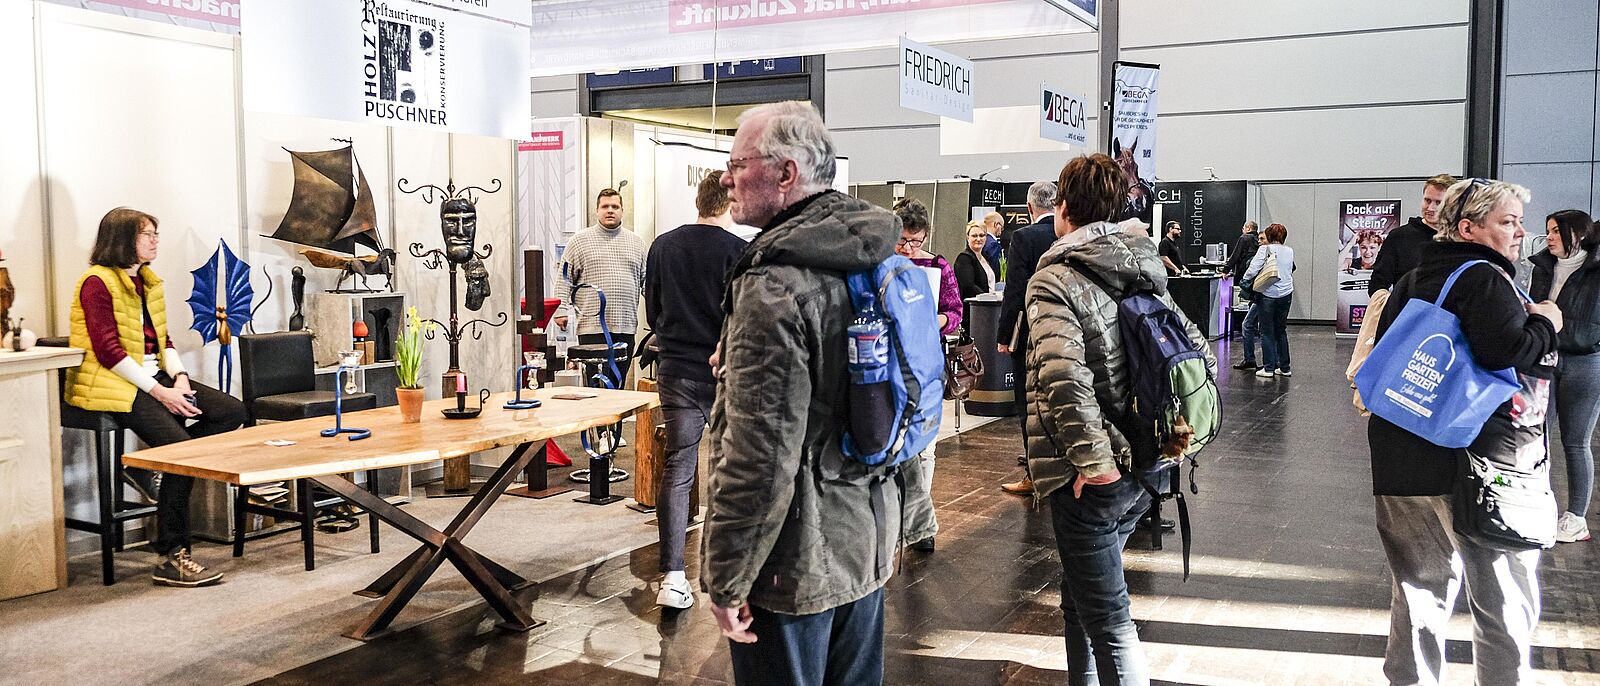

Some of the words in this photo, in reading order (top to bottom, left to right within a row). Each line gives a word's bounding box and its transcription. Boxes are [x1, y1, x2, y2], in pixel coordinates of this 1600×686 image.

[364, 34, 376, 97] HOLZ
[905, 48, 969, 96] FRIEDRICH
[1128, 91, 1148, 99] BEGA
[365, 101, 447, 125] PÜSCHNER
[1055, 94, 1085, 130] BEGA
[688, 165, 716, 187] DUS
[985, 189, 1002, 200] ZECH
[1155, 190, 1181, 200] CH
[1006, 213, 1029, 224] 75
[1191, 189, 1203, 246] berühren
[1346, 204, 1373, 215] Bock
[1375, 203, 1395, 215] auf
[1352, 218, 1388, 229] Stein?
[1412, 350, 1437, 367] HAUS
[1401, 368, 1438, 392] FREIZEIT
[1408, 360, 1445, 384] GARTEN
